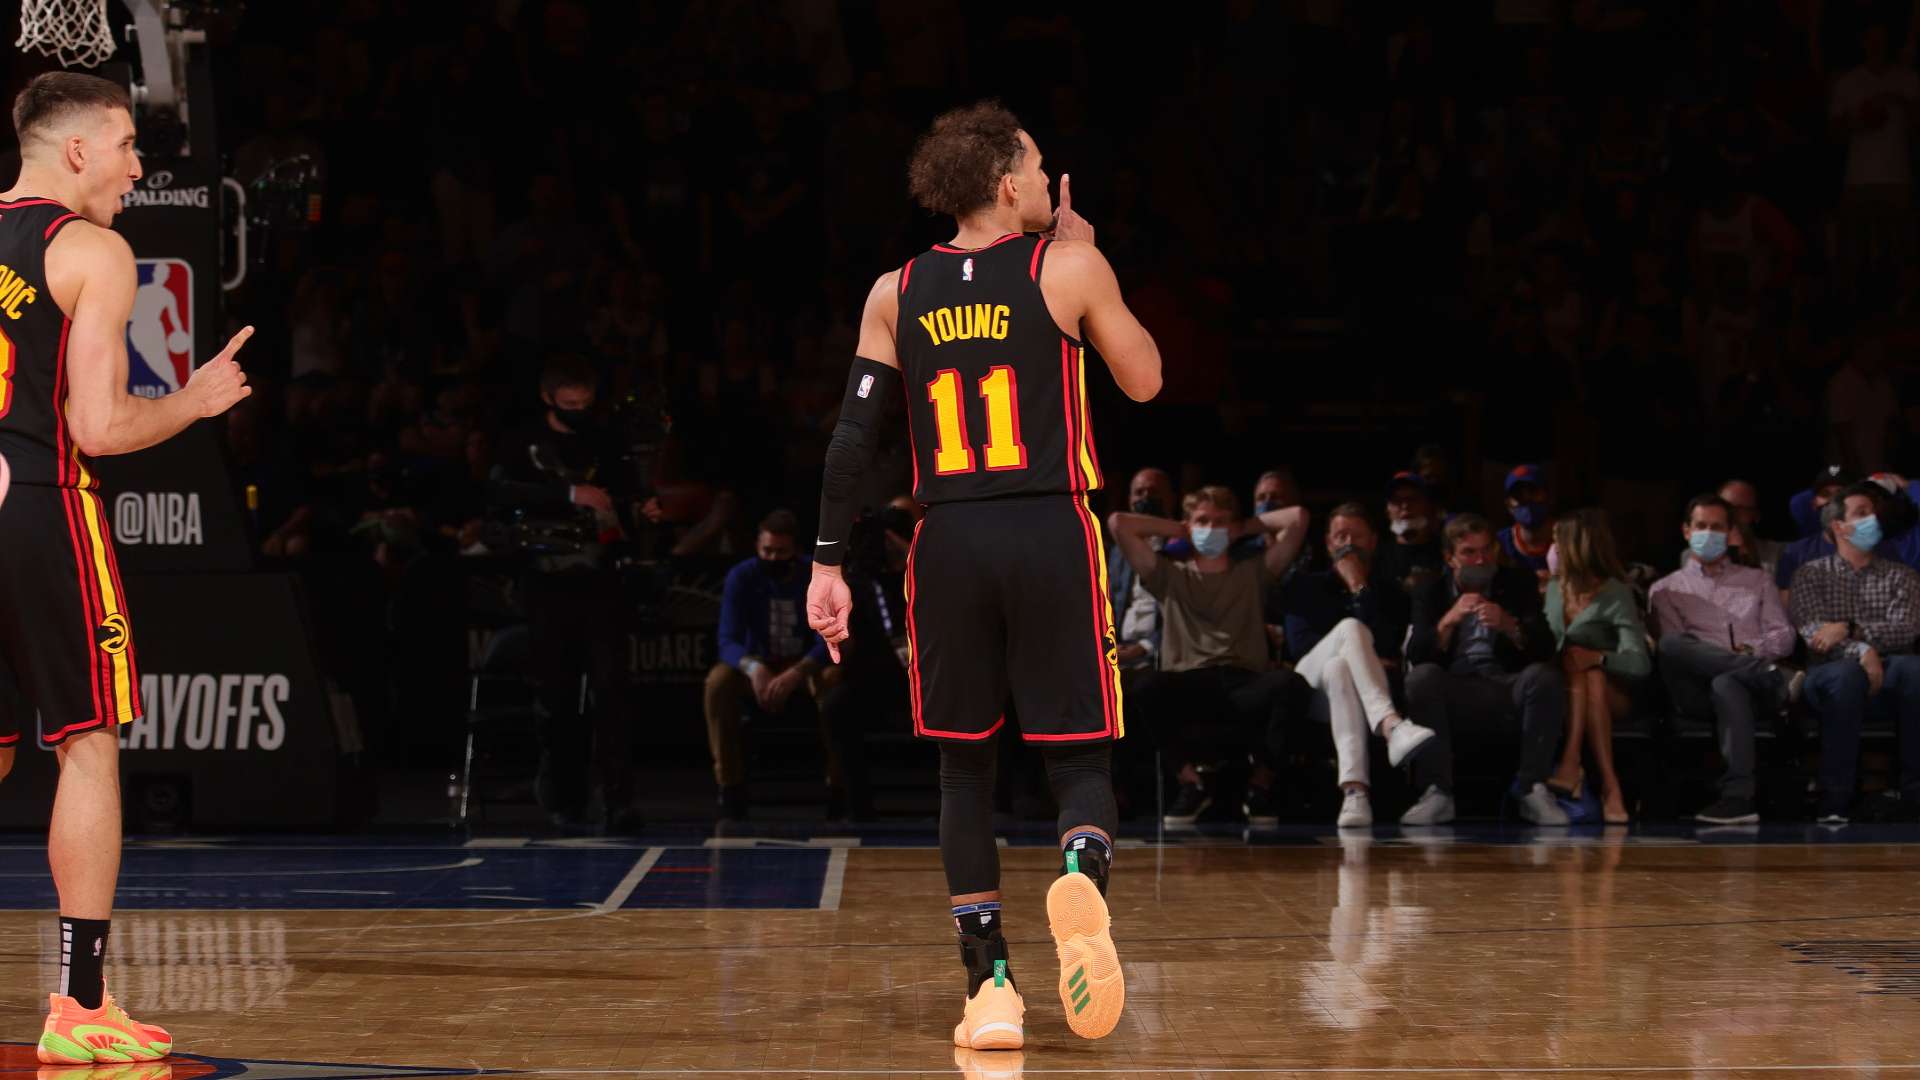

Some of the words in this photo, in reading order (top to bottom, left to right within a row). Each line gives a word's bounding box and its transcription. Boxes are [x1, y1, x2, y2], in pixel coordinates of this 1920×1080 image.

[918, 303, 1010, 346] YOUNG
[926, 364, 1028, 476] 11
[114, 491, 204, 545] @NBA
